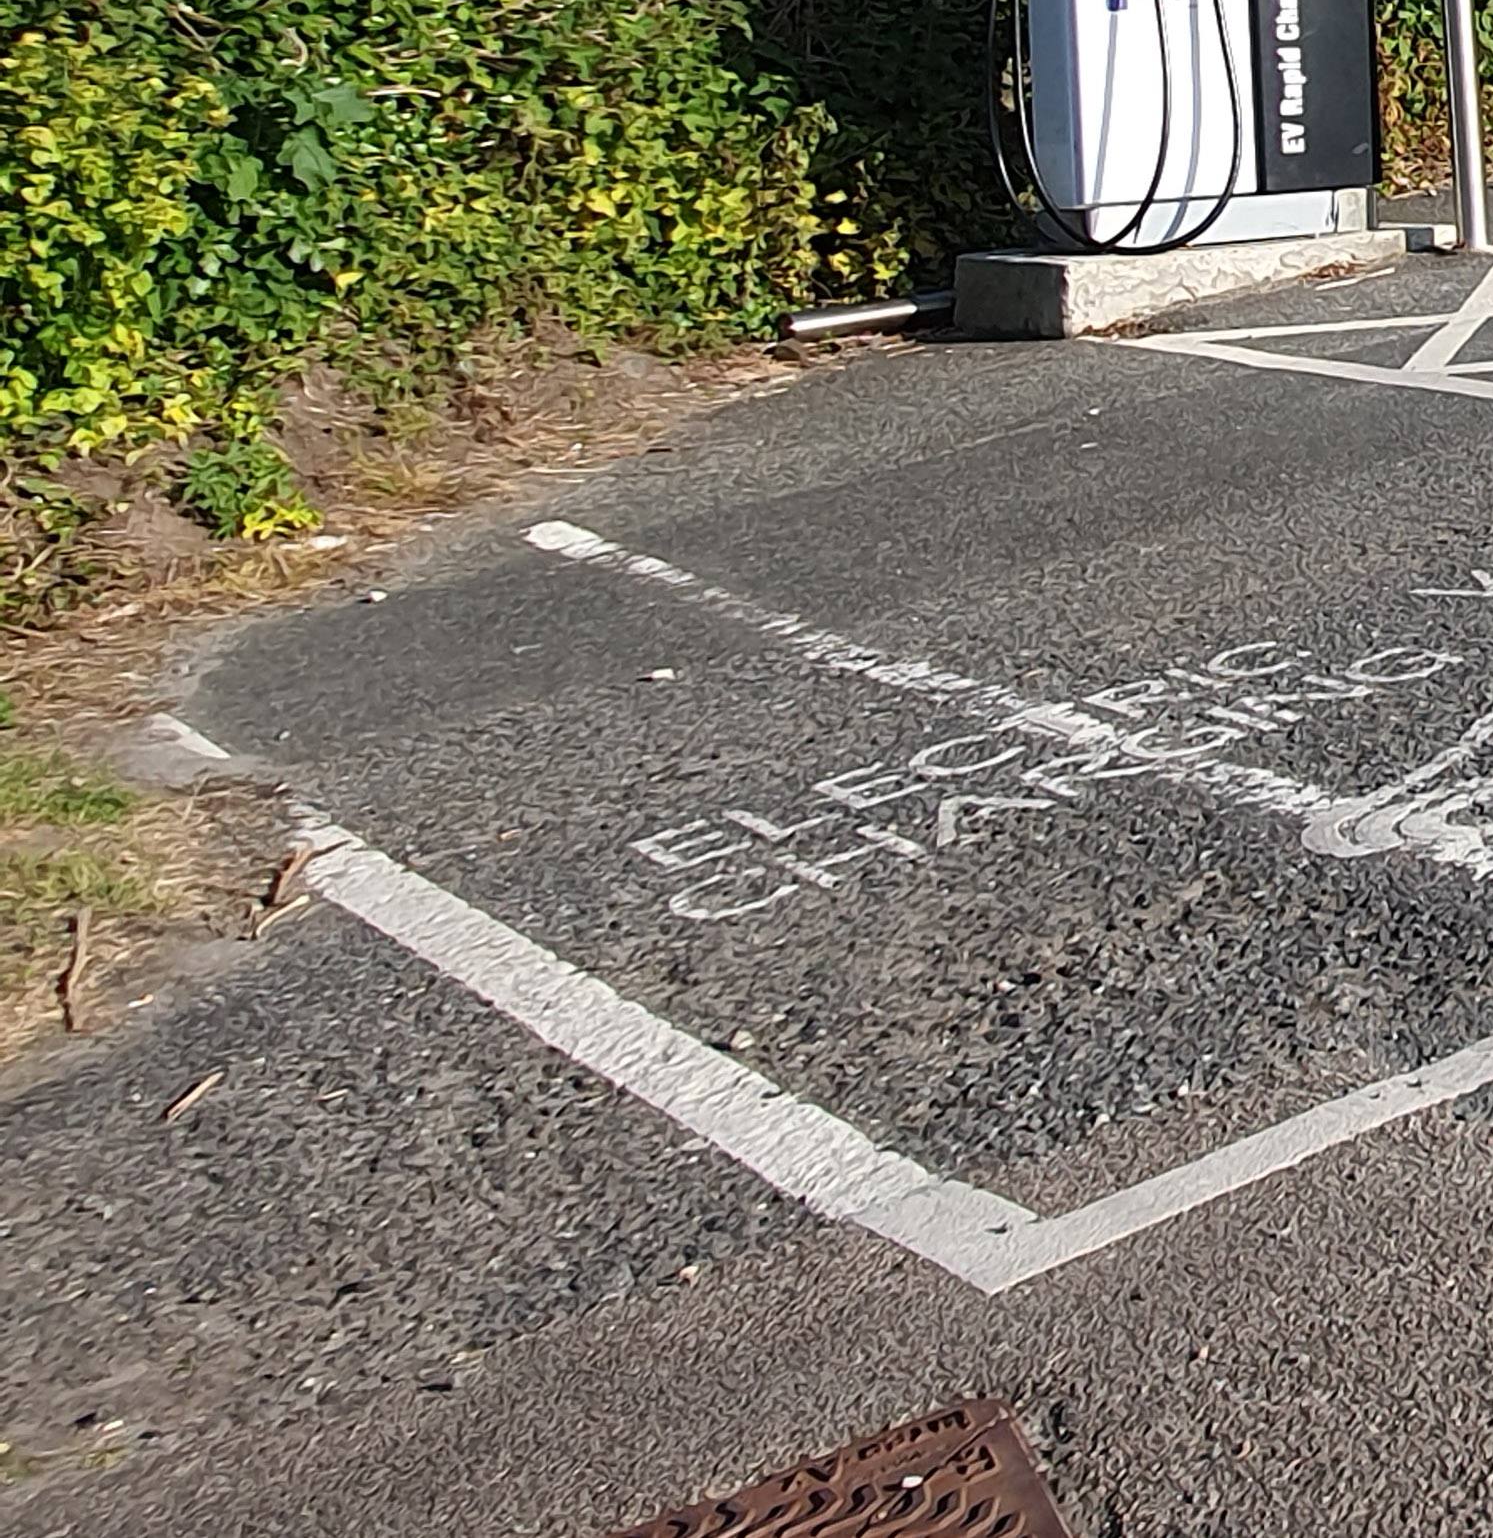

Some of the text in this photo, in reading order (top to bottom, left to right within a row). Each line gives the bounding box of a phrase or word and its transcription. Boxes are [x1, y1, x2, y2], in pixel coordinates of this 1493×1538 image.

[1276, 46, 1307, 117] Rapid
[1280, 121, 1306, 155] EV
[627, 640, 1312, 869] ELECTRIC
[669, 646, 1464, 920] CHARGING
